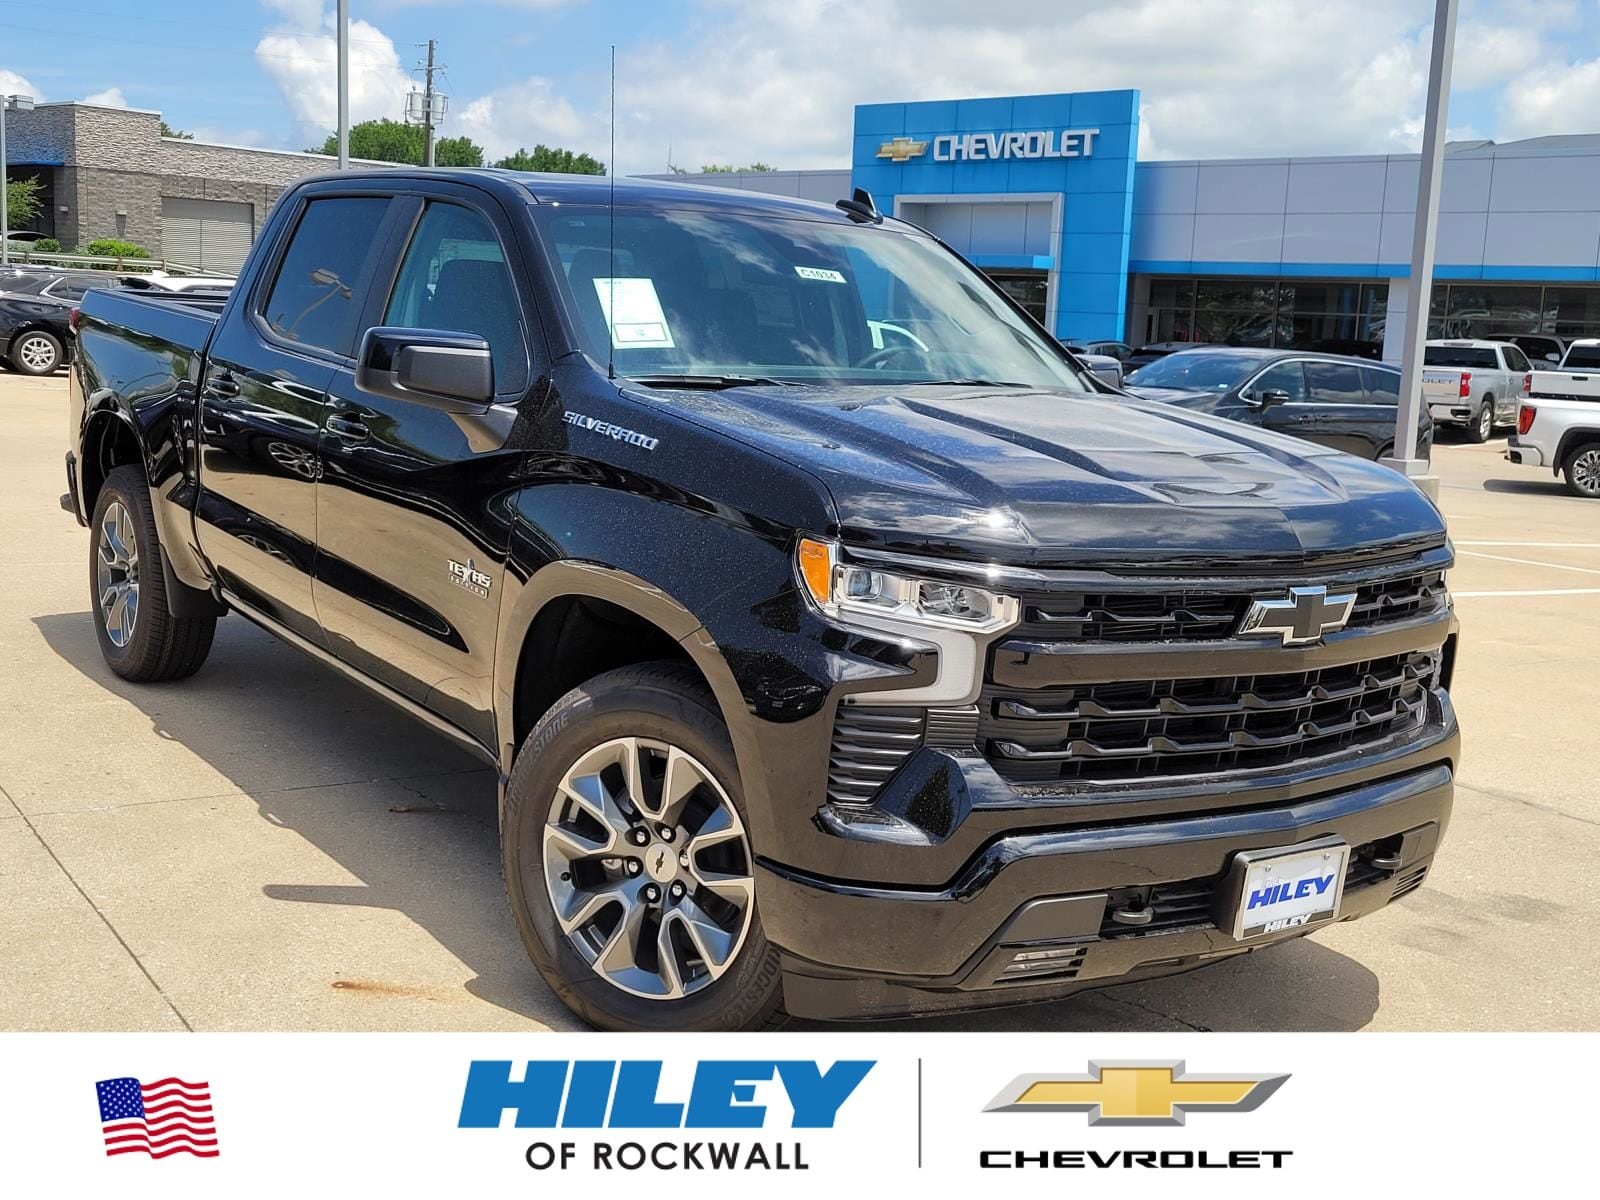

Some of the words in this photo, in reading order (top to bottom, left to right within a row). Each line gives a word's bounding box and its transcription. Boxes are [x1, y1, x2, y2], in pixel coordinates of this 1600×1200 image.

[933, 128, 1100, 162] CHEVROLET
[800, 269, 837, 280] C1034
[562, 410, 660, 451] SILVERADO
[447, 559, 492, 588] TEXAS
[1247, 873, 1335, 910] HILEY
[1263, 913, 1312, 933] HILEY
